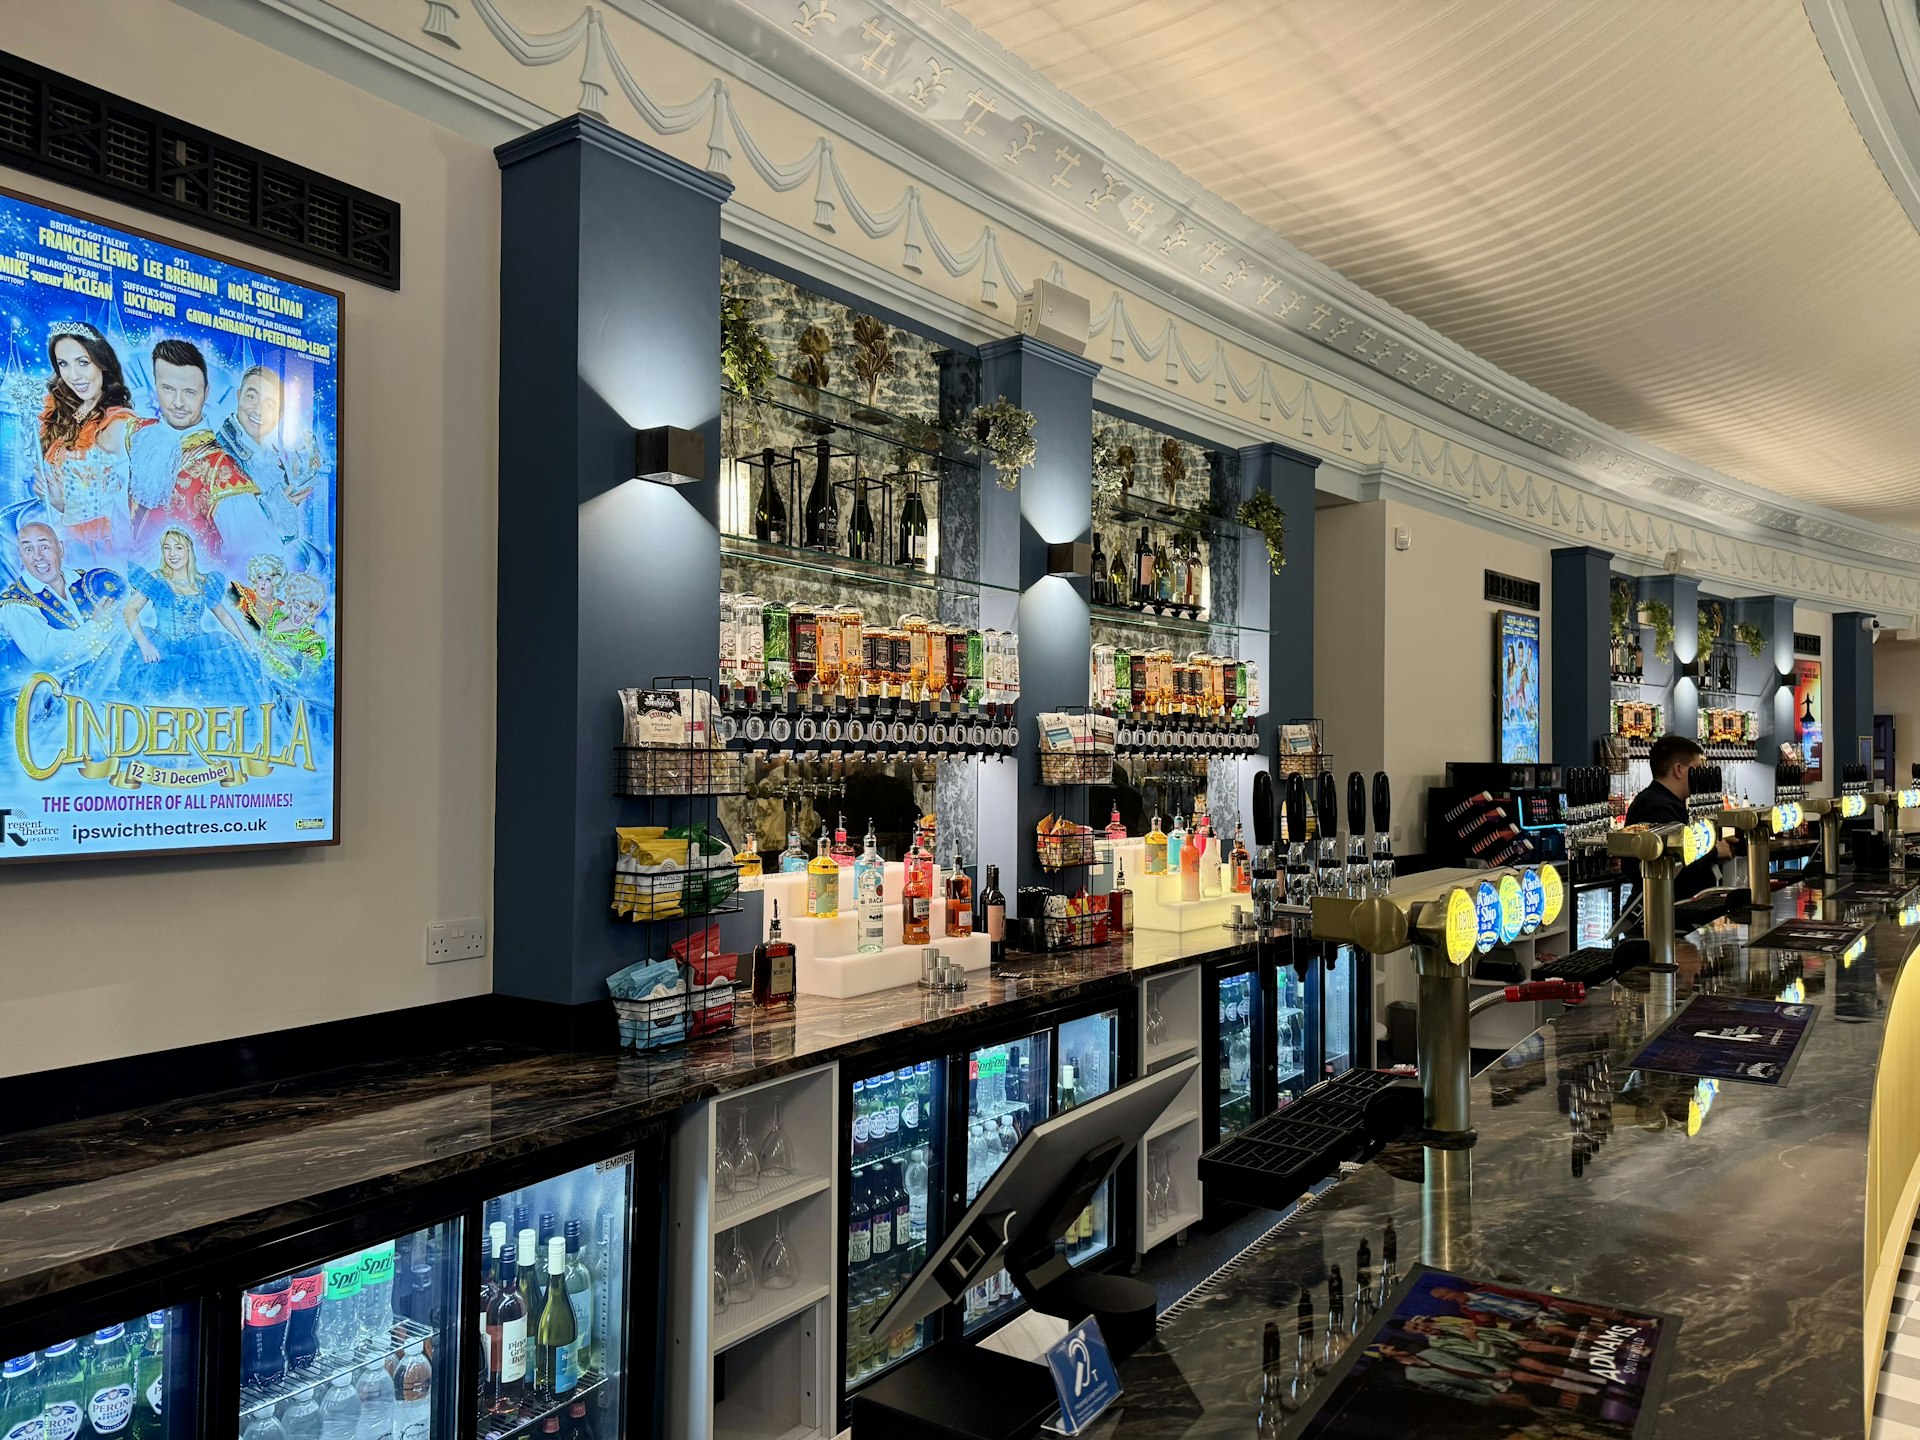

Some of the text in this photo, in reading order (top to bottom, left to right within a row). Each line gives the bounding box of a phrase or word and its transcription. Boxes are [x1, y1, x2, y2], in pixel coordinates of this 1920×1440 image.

[50, 220, 129, 250] BRITAIN'S GOT TALENT
[38, 226, 139, 272] FRANCINE LEWIS
[15, 250, 99, 280] 10TH HILARIOUS YEAR!
[82, 258, 112, 272] GODMOTHER
[174, 257, 190, 270] 911
[0, 254, 30, 279] MIKE
[63, 272, 112, 300] McCLEAN
[144, 258, 218, 296] LEE BRENNAN
[160, 281, 178, 292] PRINCE
[122, 281, 176, 302] SUFFOLK'S OWN
[124, 290, 176, 318] LUCY ROPER
[124, 307, 152, 320] CINDERELLA
[256, 290, 304, 319] SULLIVAN
[220, 308, 302, 336] BACK BY POPULAR DEMAND!
[186, 308, 330, 358] GAVIN ASHBARRY & PETER BRAD-LEIGH
[14, 671, 316, 781] CINDERELLA
[132, 764, 145, 778] 12
[153, 770, 166, 783] 31
[170, 765, 228, 784] December
[42, 793, 293, 812] THE GODMOTHER OF ALL PANTOMIMES!
[8, 820, 42, 832] regent
[22, 826, 58, 836] theatre
[72, 818, 268, 844] ipswichtheatres.co.uk
[1526, 891, 1540, 908] Ship
[1481, 906, 1496, 924] Ship
[605, 1152, 634, 1170] EMPIRE
[1624, 1337, 1645, 1374] SOUTHWOLD
[92, 1398, 132, 1413] PERONI
[49, 1414, 78, 1428] RONI
